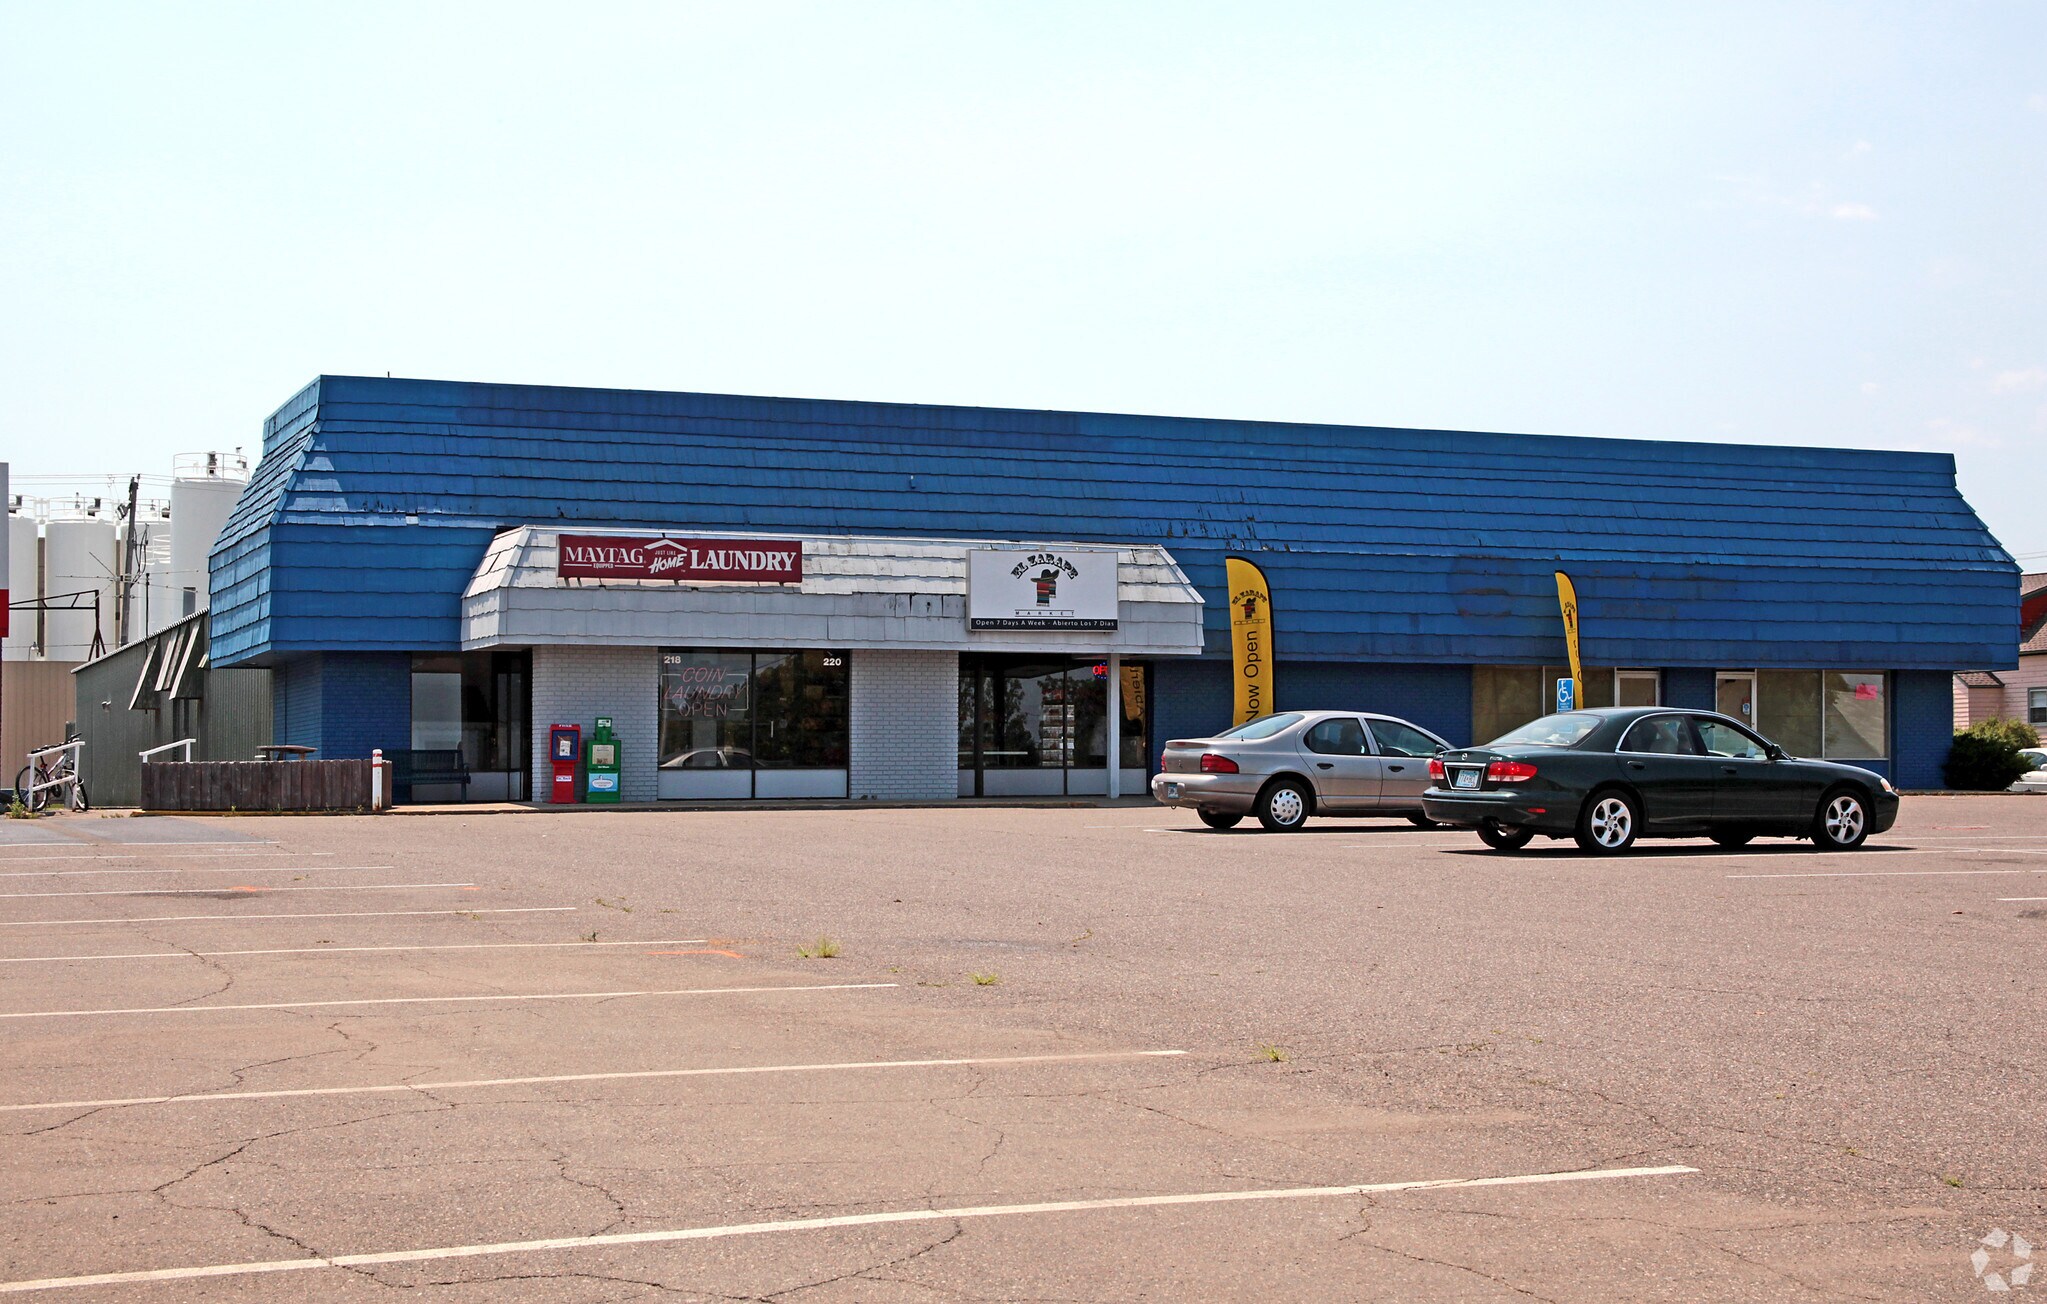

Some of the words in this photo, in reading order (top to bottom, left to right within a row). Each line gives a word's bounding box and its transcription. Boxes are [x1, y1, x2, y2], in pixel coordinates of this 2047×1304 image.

[565, 547, 643, 563] MAYTAG
[690, 549, 797, 571] LAUNDRY
[648, 553, 687, 574] HOME
[1010, 561, 1029, 579] EL
[1027, 553, 1079, 580] ZARAPE
[1002, 620, 1019, 628] Days
[664, 656, 682, 664] 218
[823, 658, 842, 666] 220
[1244, 630, 1262, 678] Open
[682, 667, 726, 683] COIN
[1092, 665, 1108, 676] OP
[663, 684, 746, 701] LAUNDRY
[679, 701, 727, 717] OPEN
[1245, 684, 1260, 722] Now
